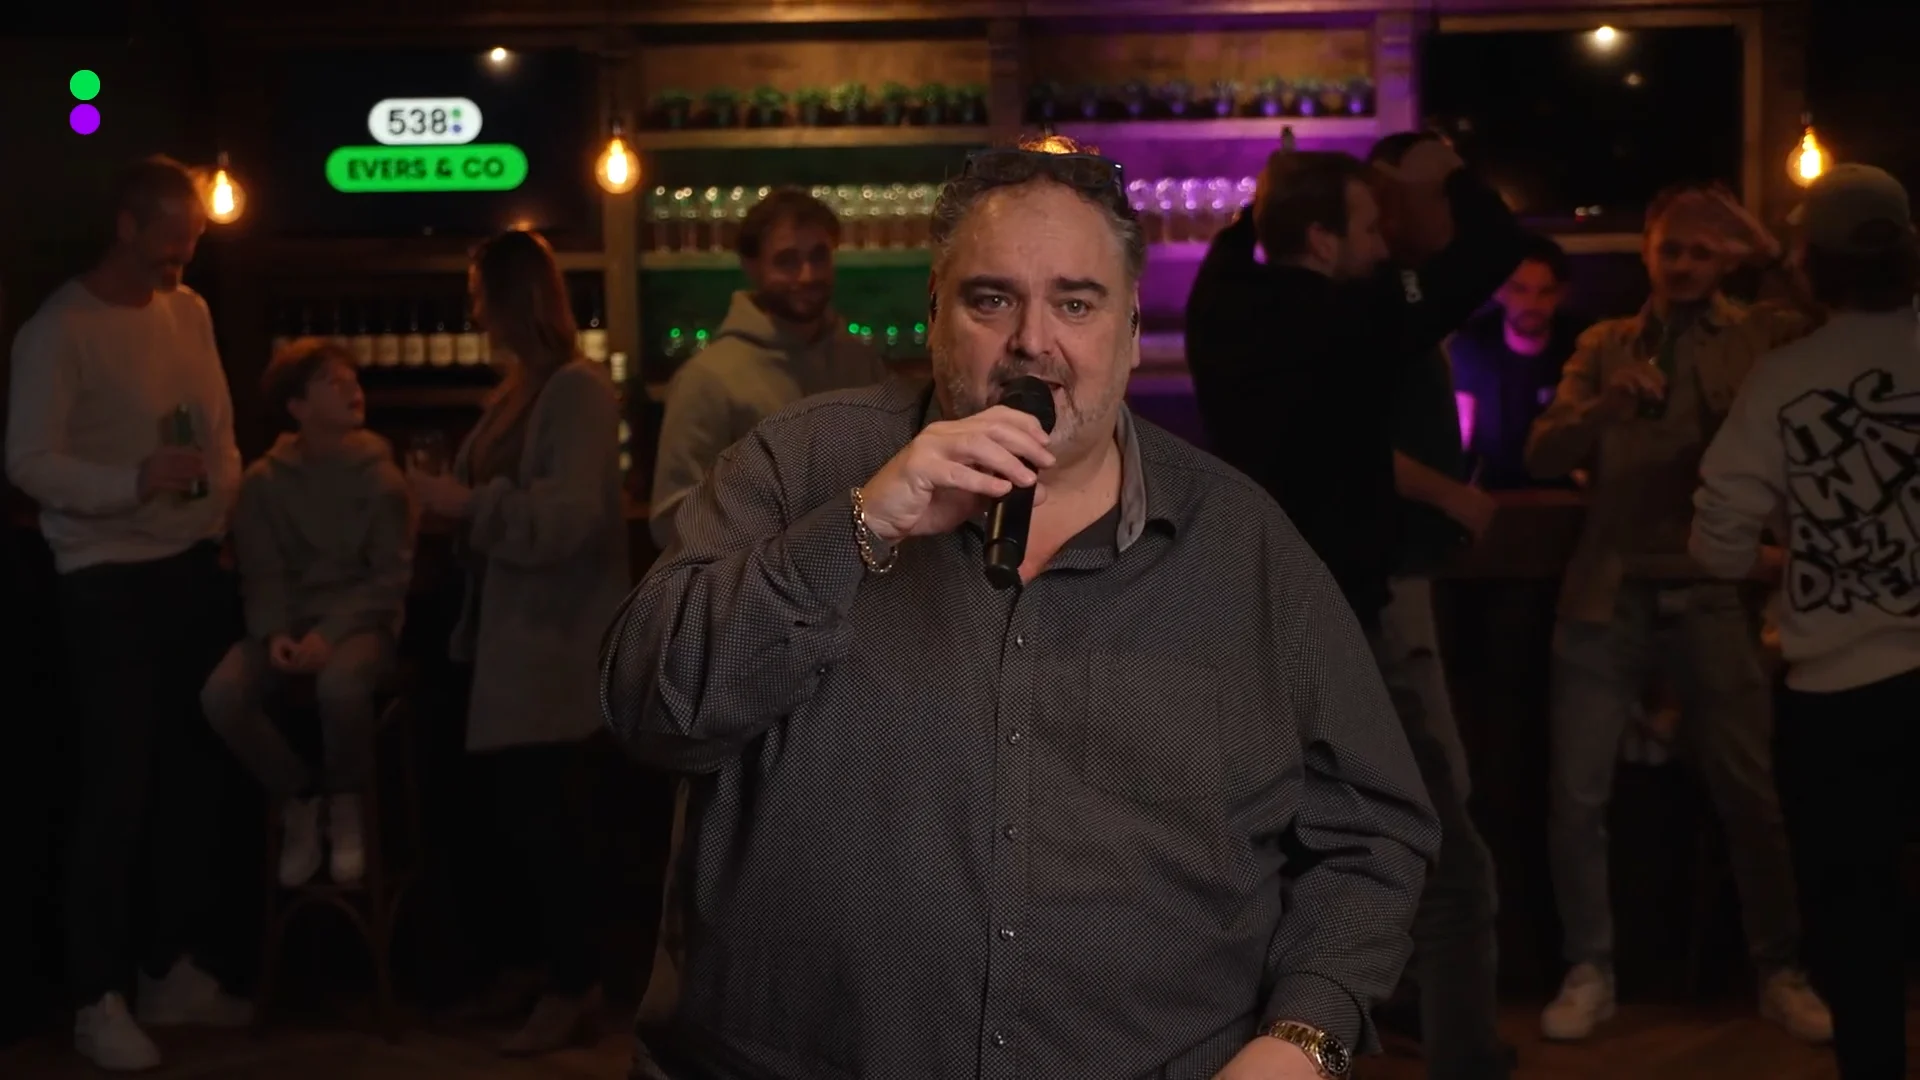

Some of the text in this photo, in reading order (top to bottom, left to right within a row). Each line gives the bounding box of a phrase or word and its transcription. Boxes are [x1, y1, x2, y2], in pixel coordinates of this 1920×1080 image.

[388, 108, 447, 136] 538
[347, 155, 505, 181] EVERS & CO
[1786, 412, 1920, 530] WA
[1787, 553, 1920, 618] DRE
